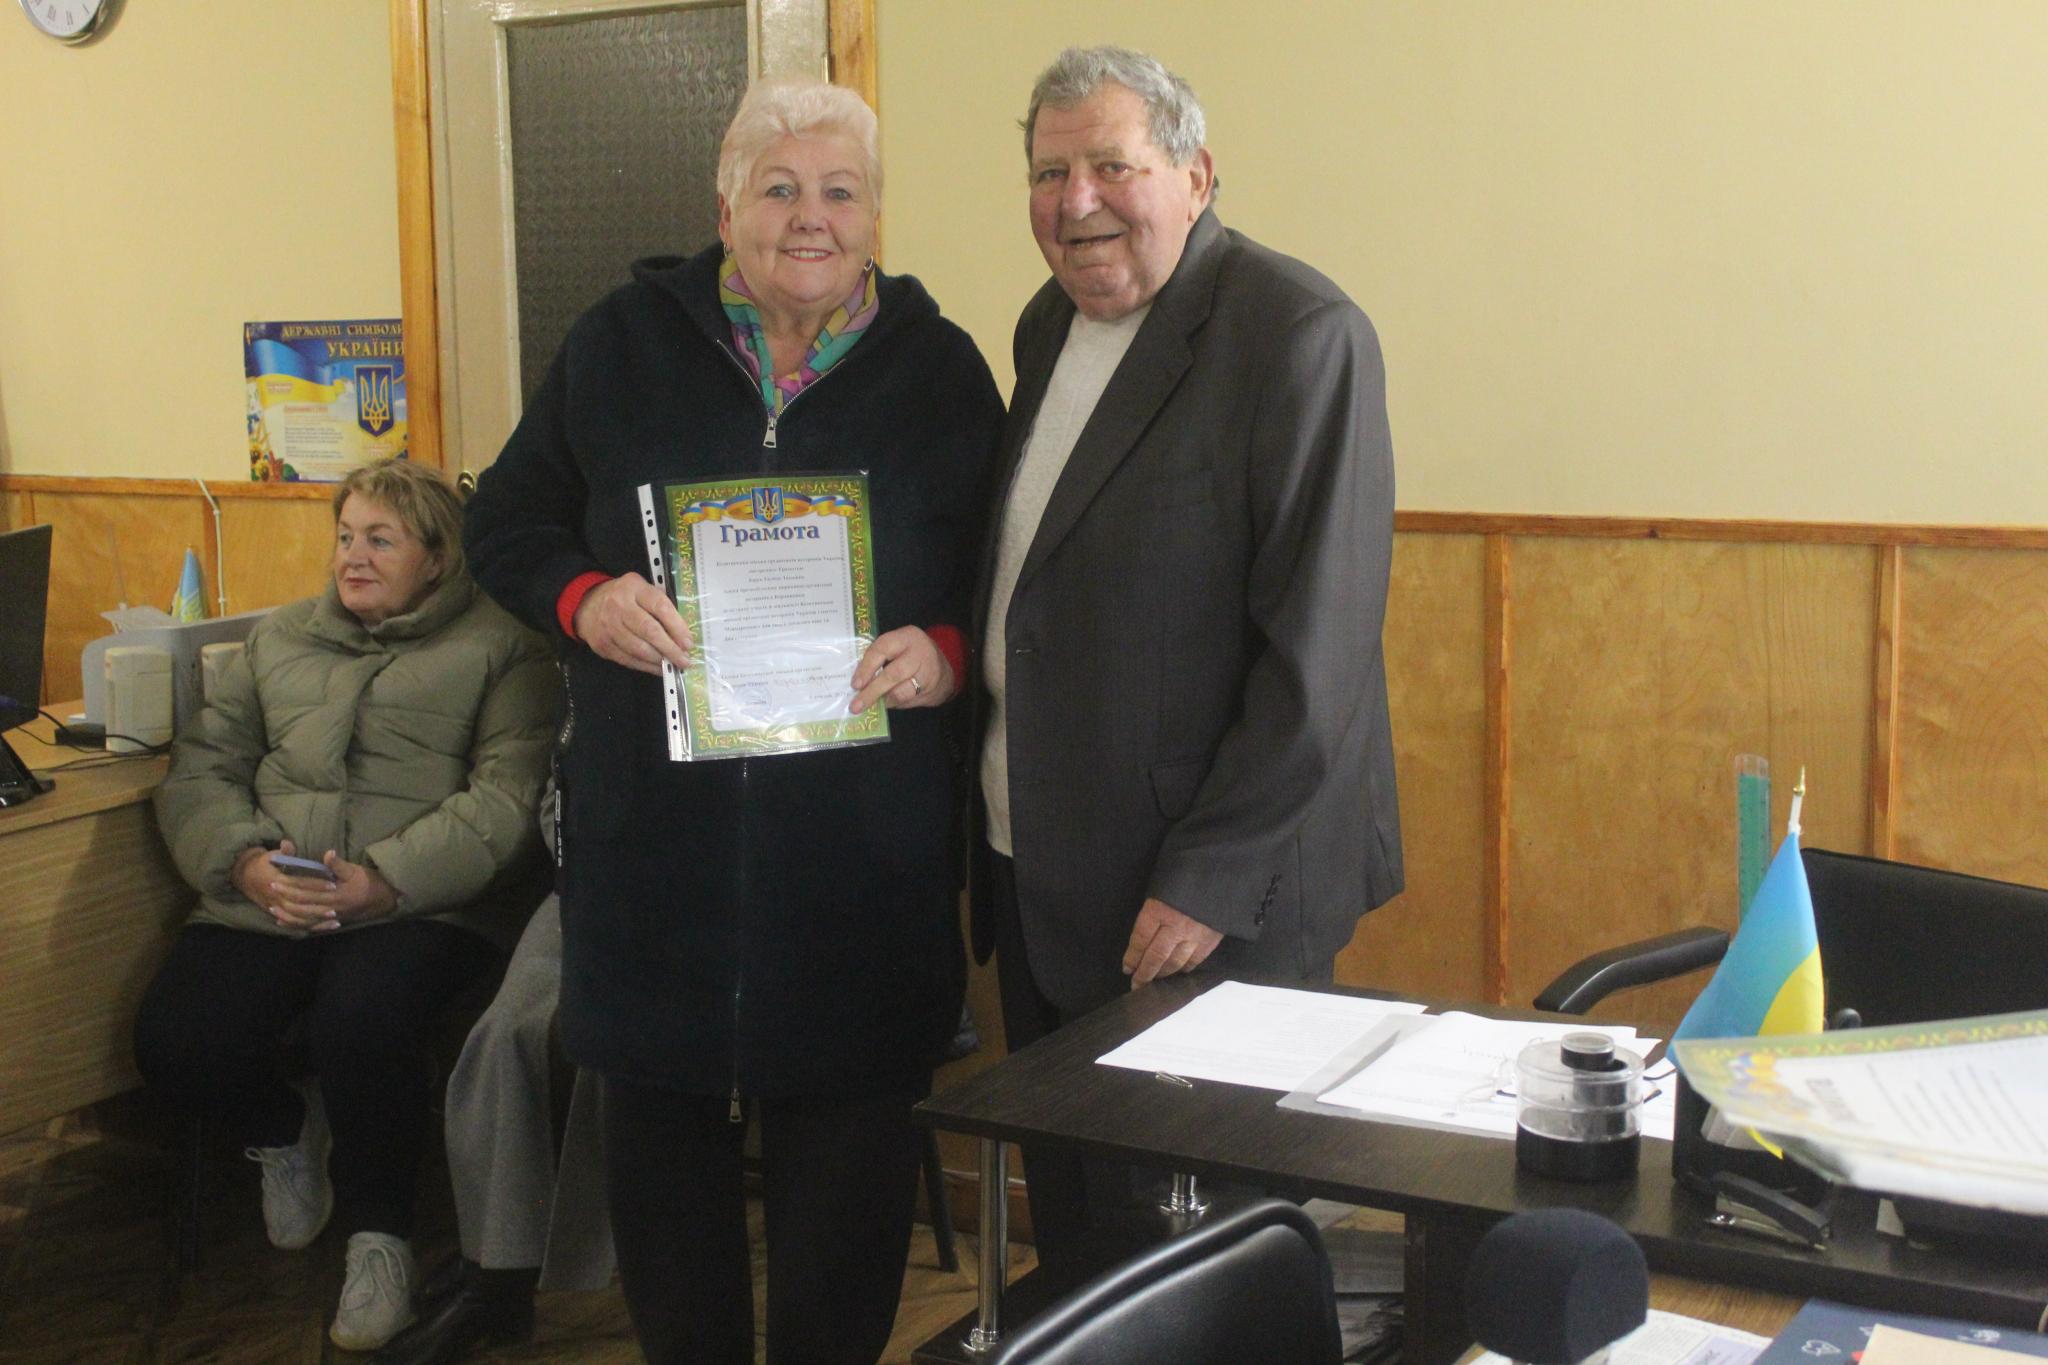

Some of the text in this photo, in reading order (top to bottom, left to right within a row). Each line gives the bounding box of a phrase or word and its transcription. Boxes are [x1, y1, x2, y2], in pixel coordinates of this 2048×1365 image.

[282, 325, 341, 338] ДЕРЖАВНІ
[327, 336, 404, 357] УКРАЇНИ
[720, 524, 820, 547] Грамота
